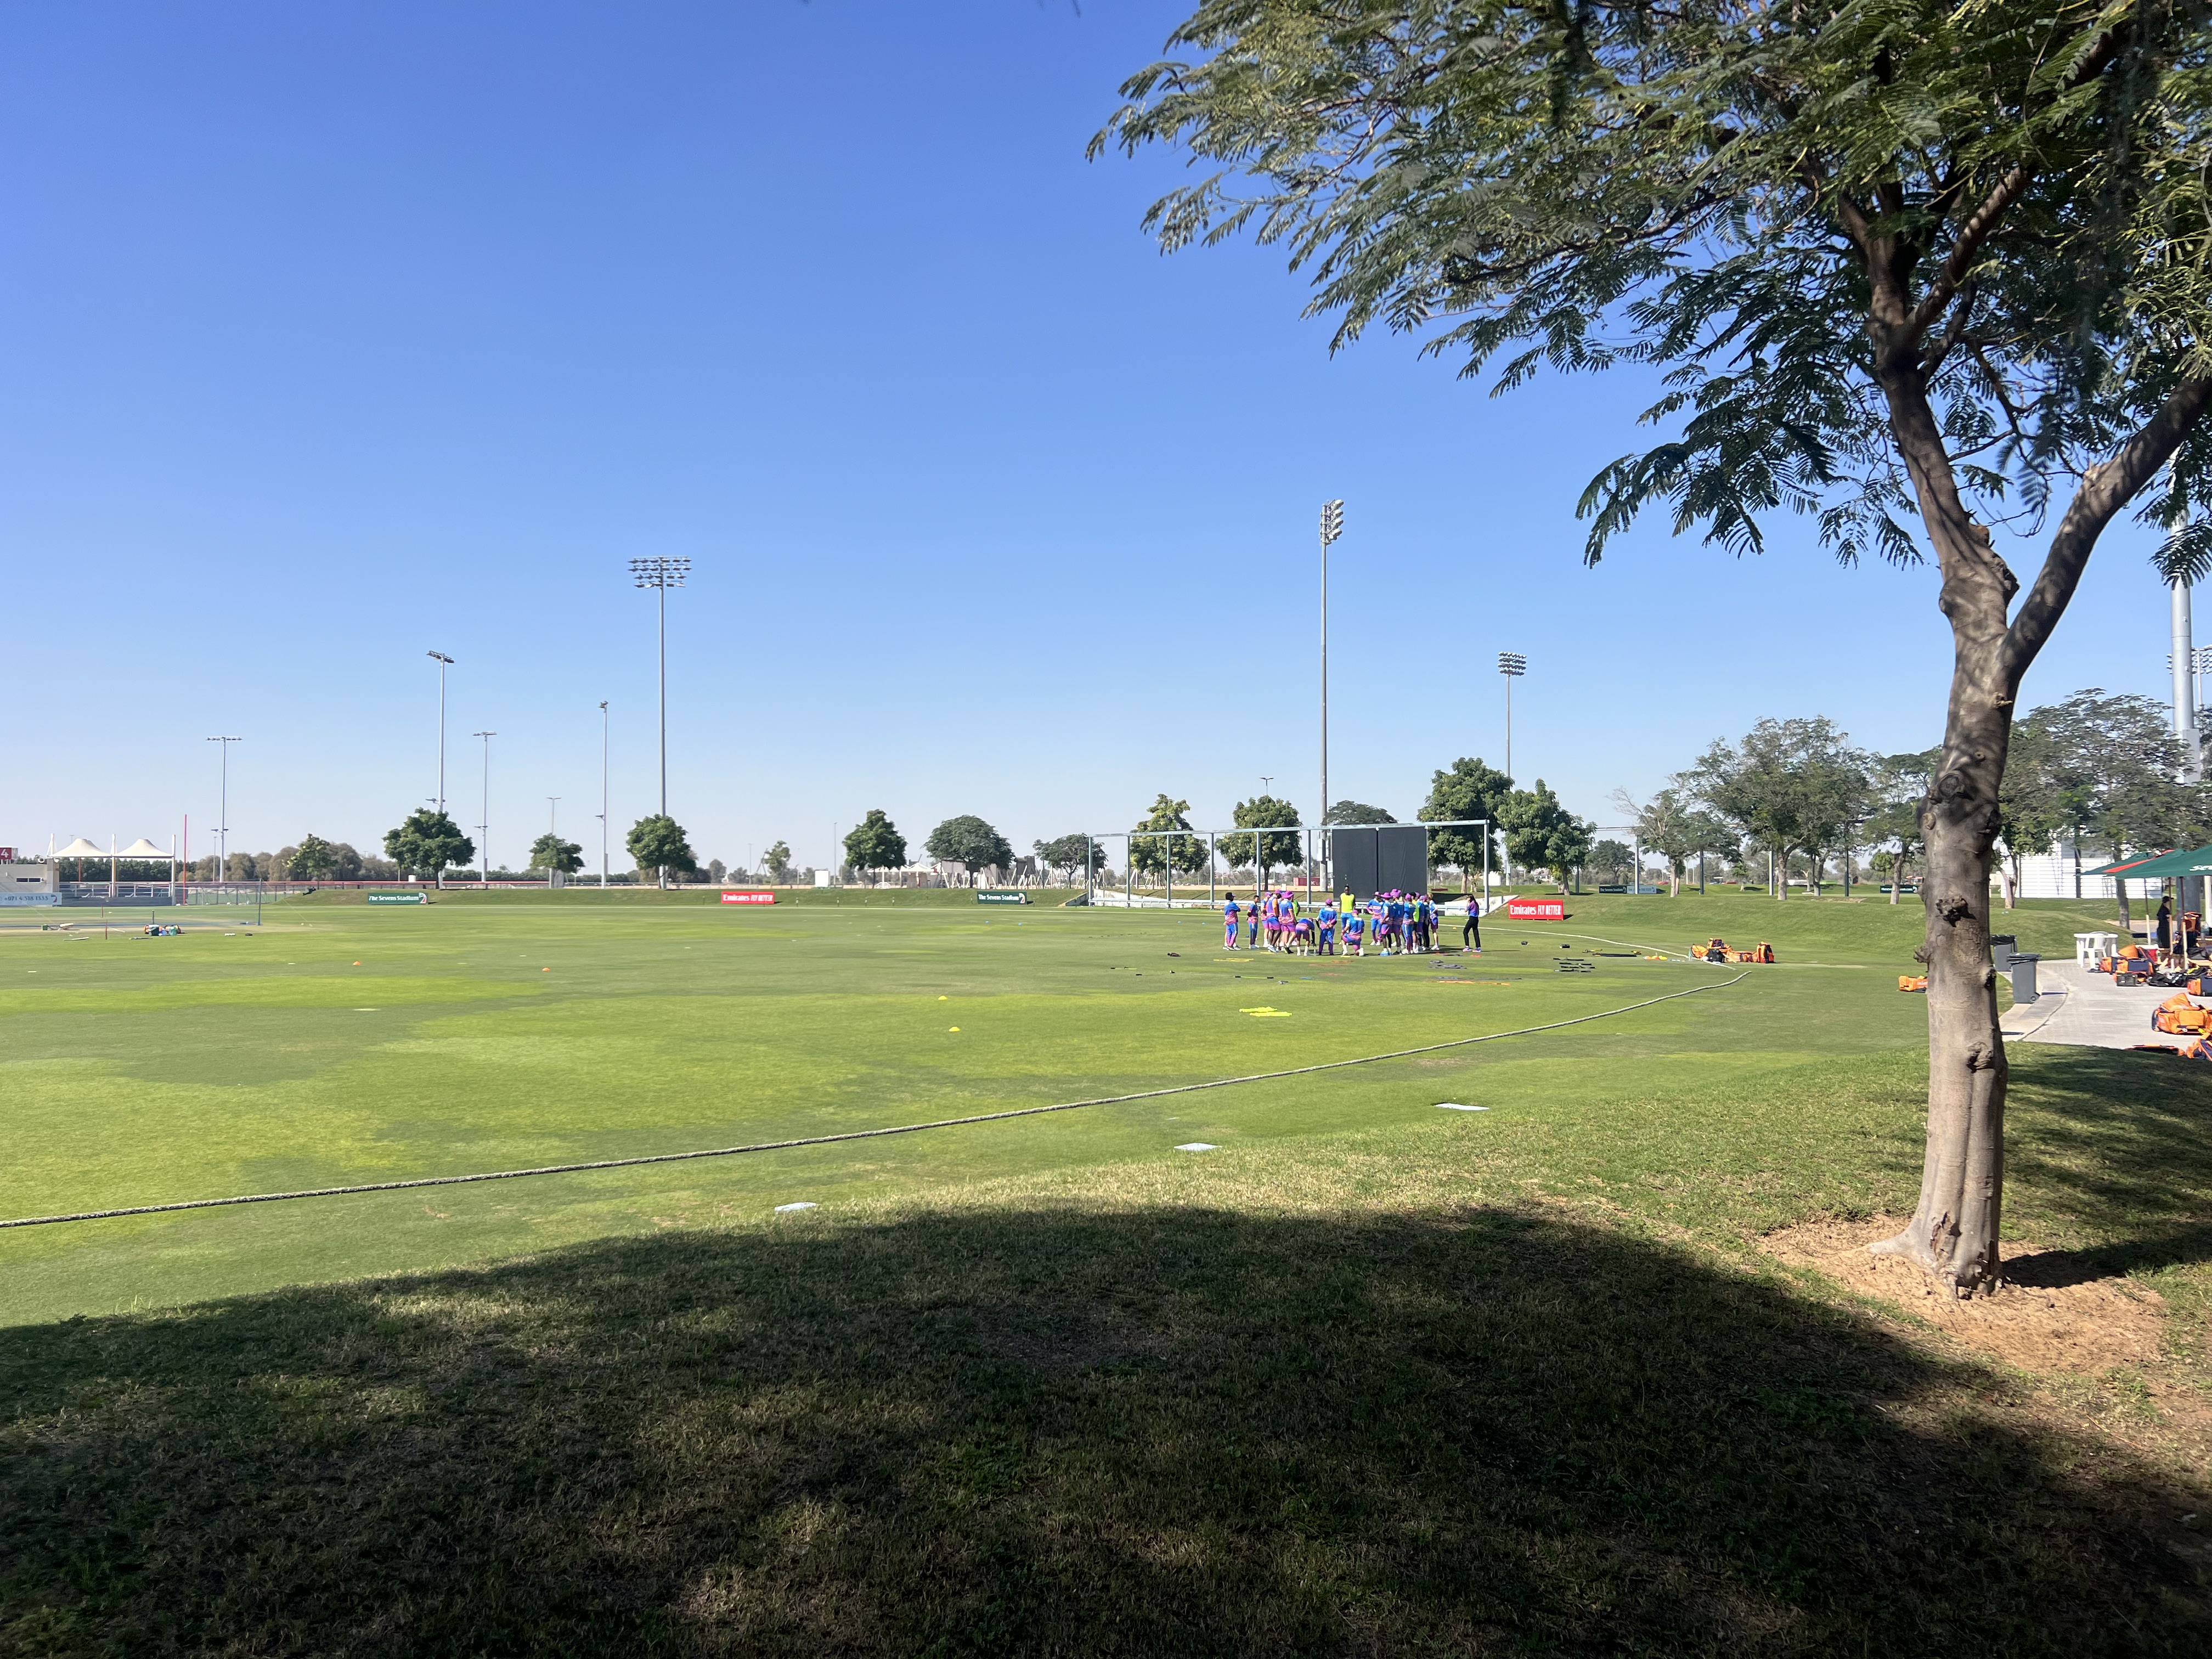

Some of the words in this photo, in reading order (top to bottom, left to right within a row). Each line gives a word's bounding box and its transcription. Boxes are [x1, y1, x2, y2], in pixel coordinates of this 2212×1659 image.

[1, 848, 9, 858] 4
[1509, 905, 1537, 915] Emirates
[1537, 905, 1545, 915] FLY
